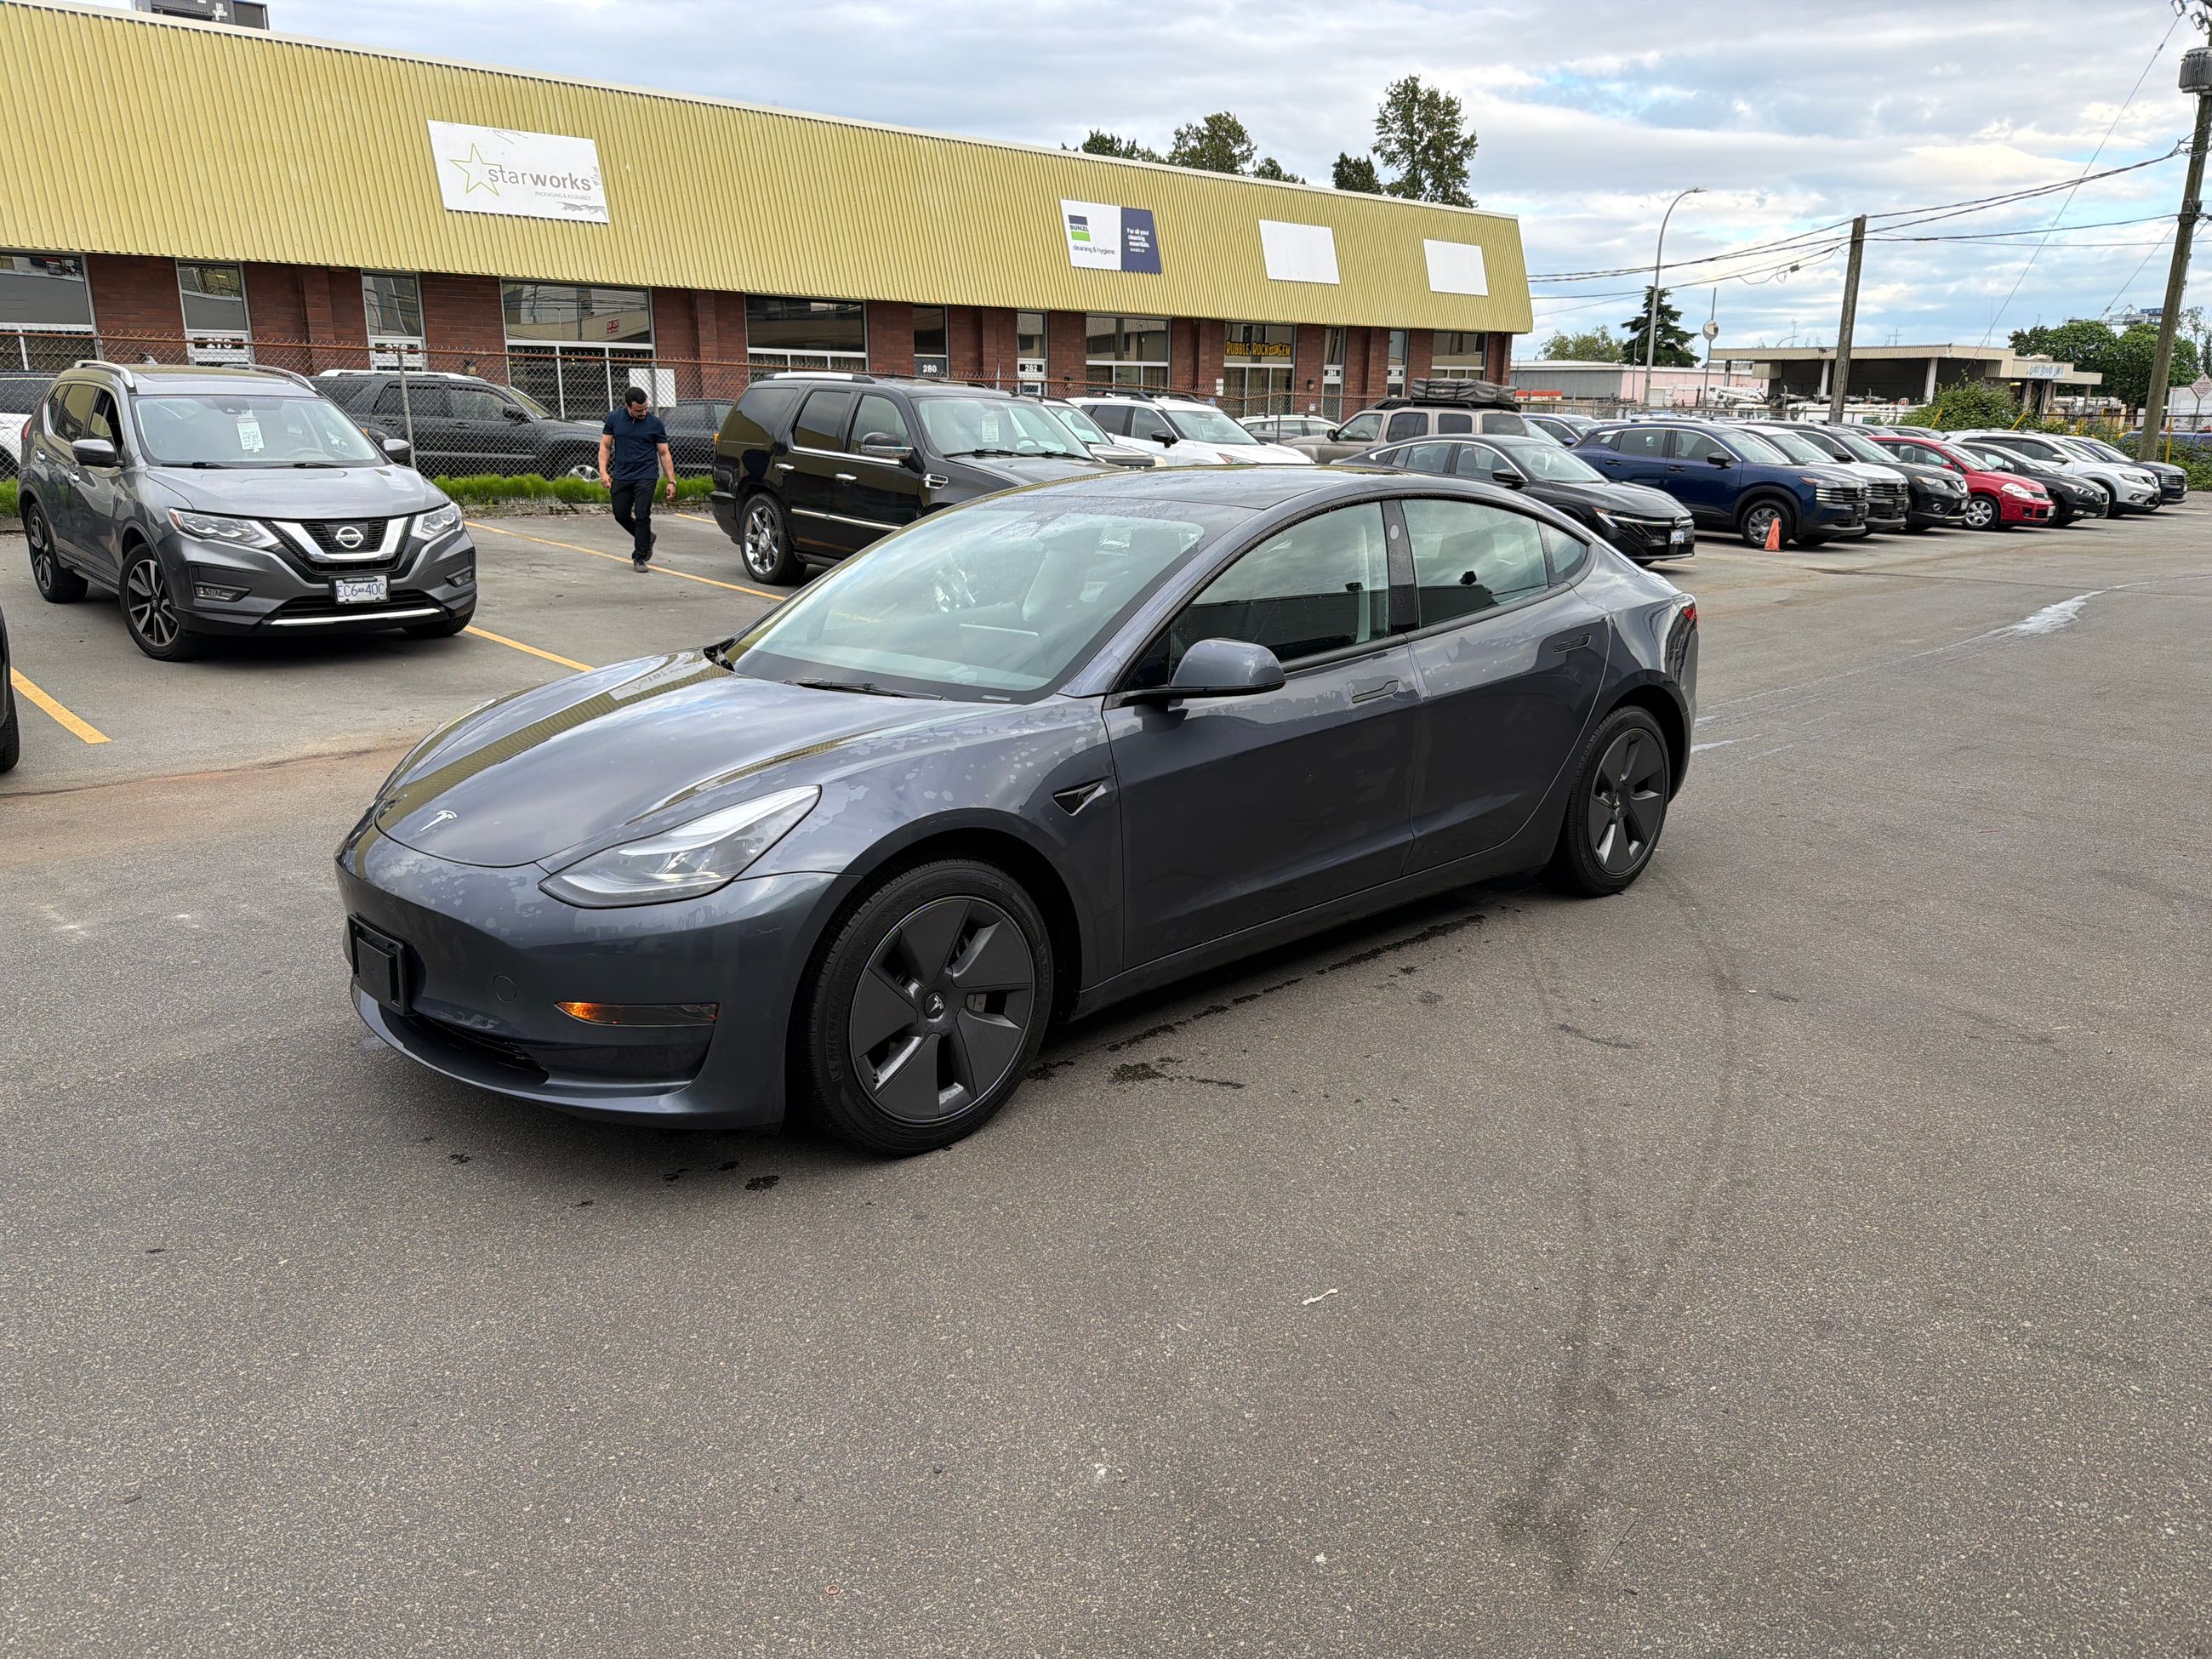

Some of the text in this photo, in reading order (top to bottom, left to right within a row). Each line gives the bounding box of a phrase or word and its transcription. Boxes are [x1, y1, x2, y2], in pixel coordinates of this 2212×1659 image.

[488, 164, 591, 191] starworks
[535, 191, 562, 199] PACKAGING
[1073, 245, 1092, 254] cleaning
[1097, 247, 1115, 255] hygiene
[1226, 340, 1250, 356] RUBBLE
[1252, 341, 1269, 356] ROCK
[1278, 342, 1291, 356] GEM
[922, 364, 938, 373] 280
[336, 583, 385, 598] EC6 40C
